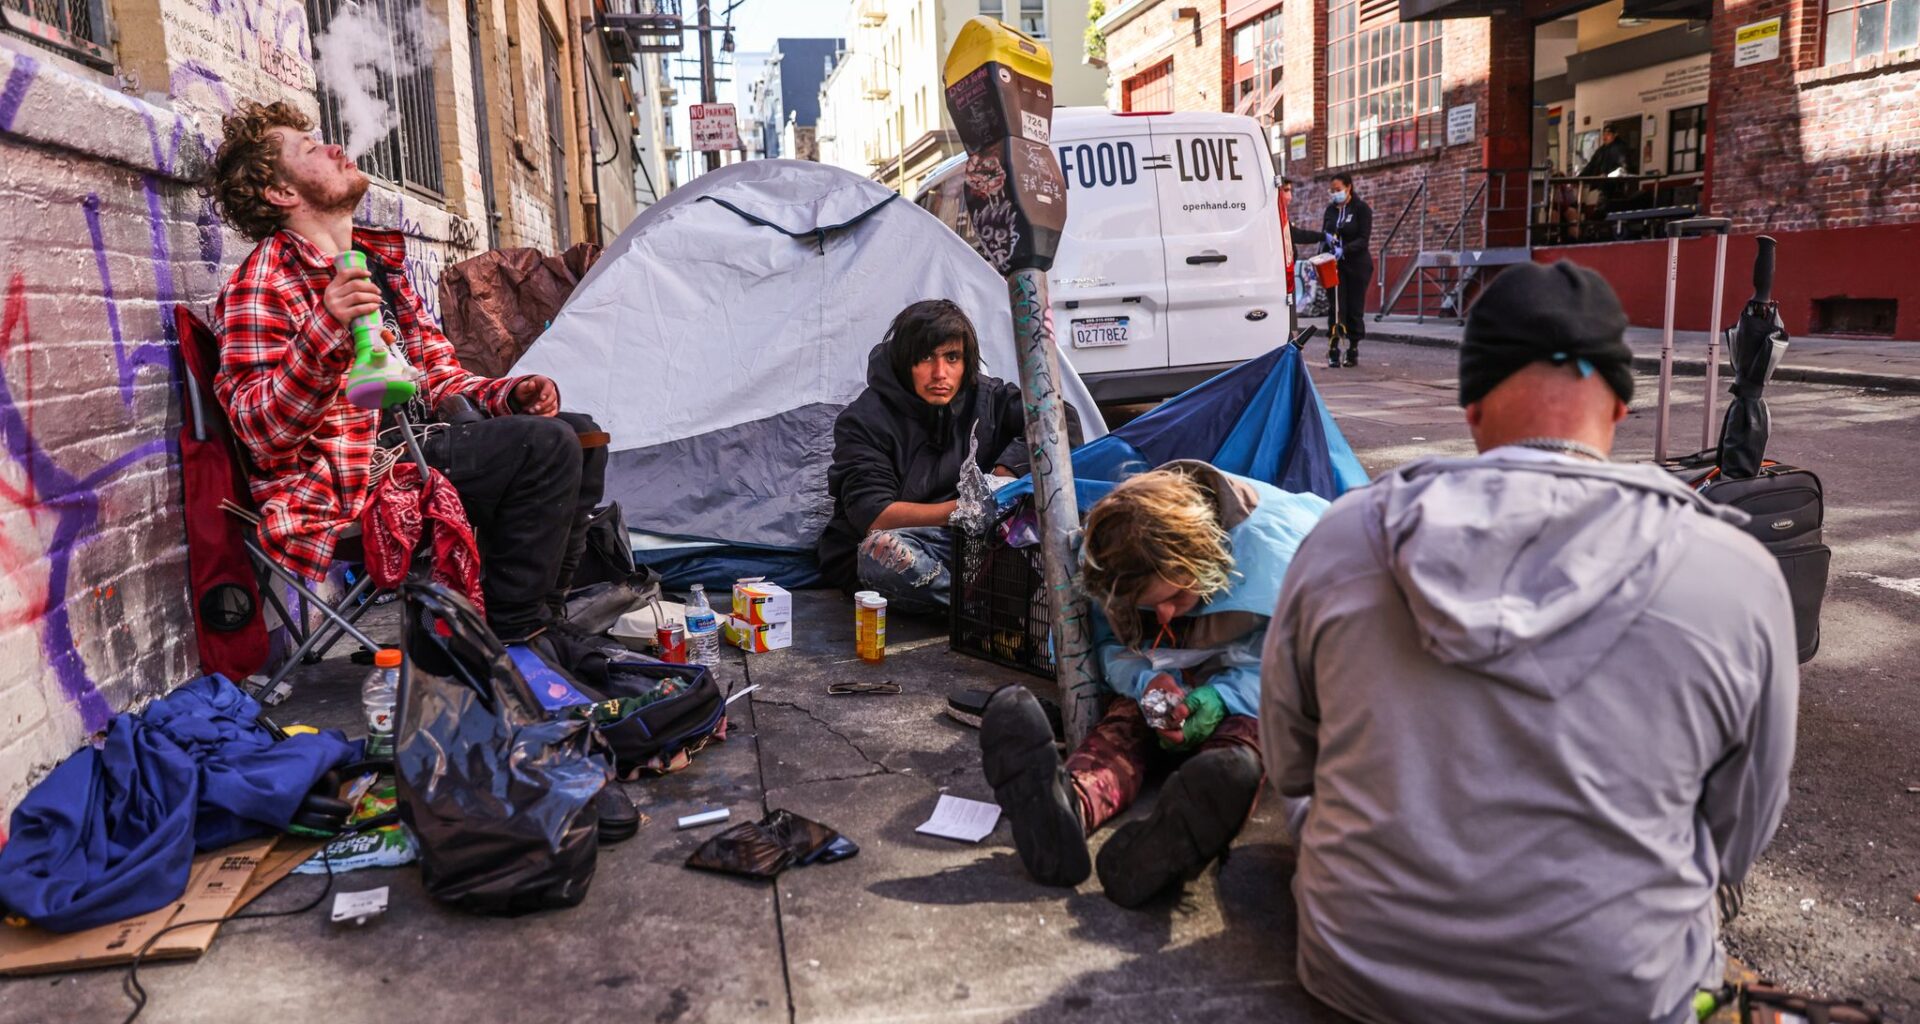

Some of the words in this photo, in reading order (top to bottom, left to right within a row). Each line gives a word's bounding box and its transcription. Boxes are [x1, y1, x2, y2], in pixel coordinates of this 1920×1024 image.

[691, 106, 703, 119] NO
[1026, 115, 1042, 128] 724
[1058, 141, 1137, 190] FOOD
[1176, 138, 1243, 182] LOVE
[1182, 201, 1246, 212] openhand.org
[1077, 327, 1128, 343] 02778E2
